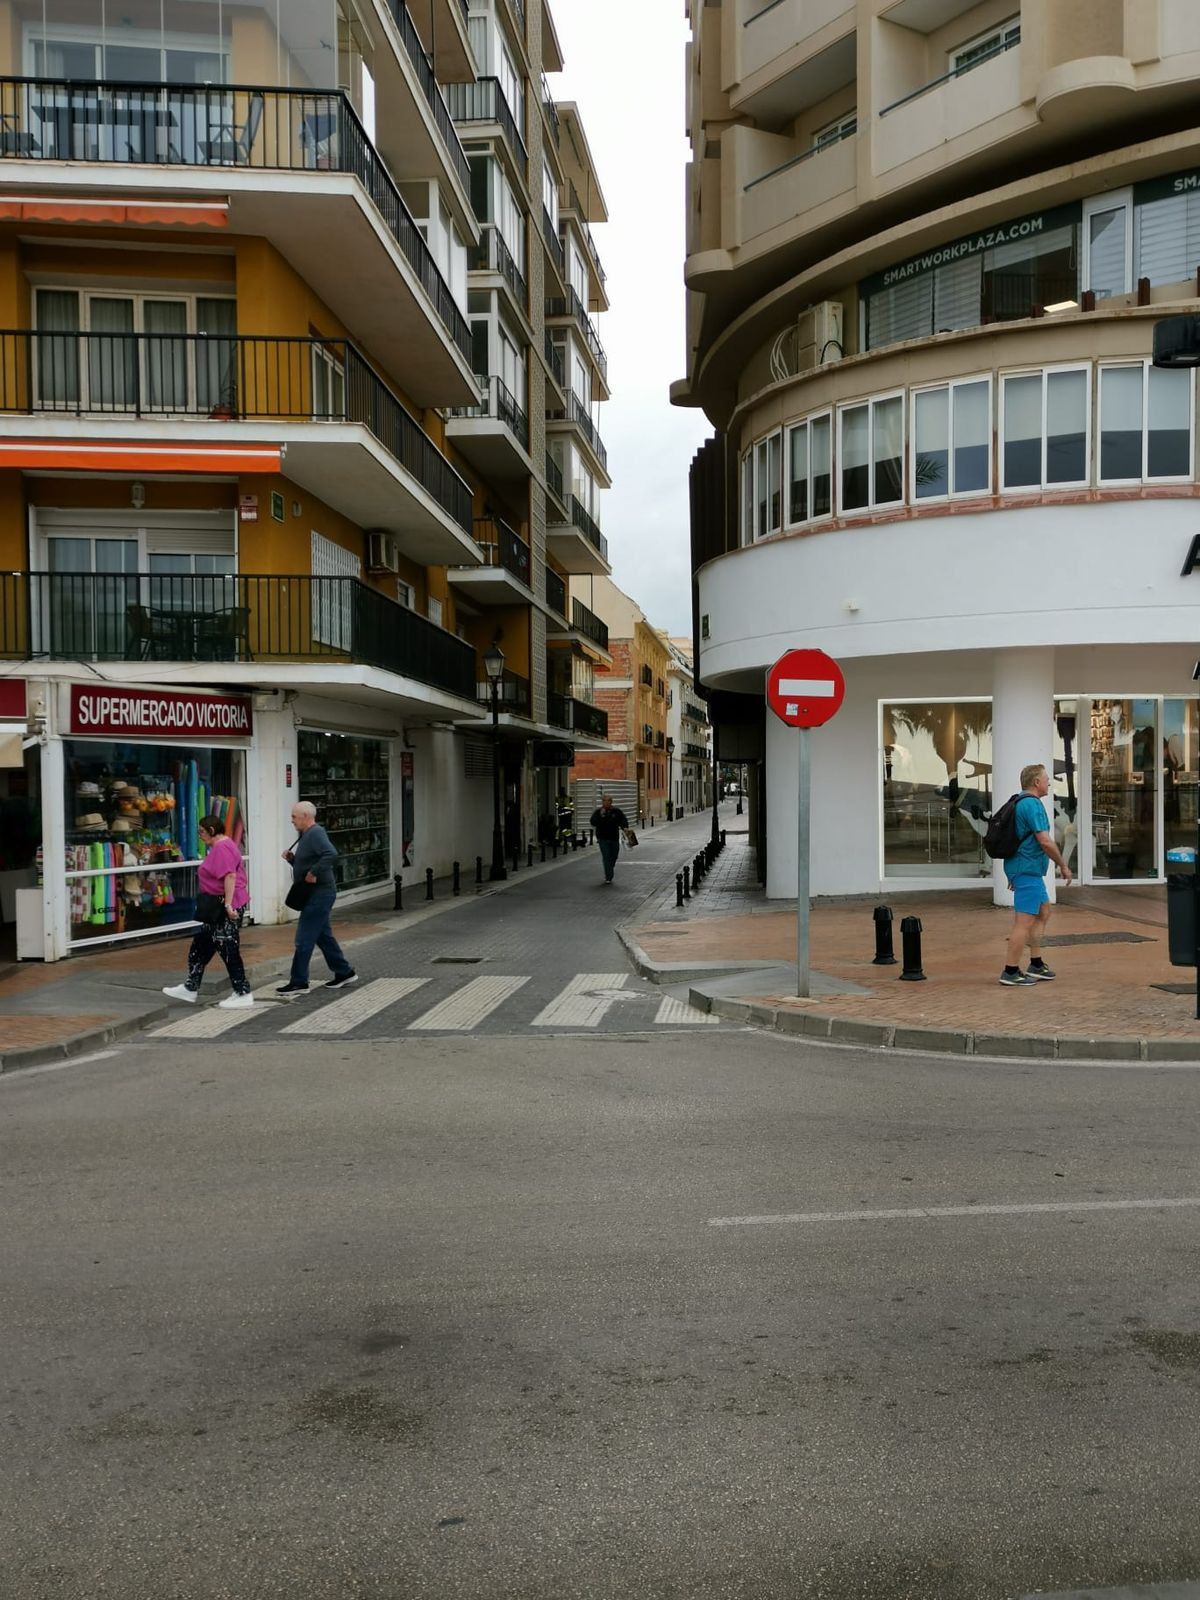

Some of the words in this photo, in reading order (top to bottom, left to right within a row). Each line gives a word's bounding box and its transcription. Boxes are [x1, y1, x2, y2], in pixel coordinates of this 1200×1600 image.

[1174, 175, 1200, 191] SM
[883, 217, 1043, 285] SMARTWORKPLAZA.COM
[79, 695, 195, 727] SUPERMERCADO
[196, 702, 248, 728] VICTORIA
